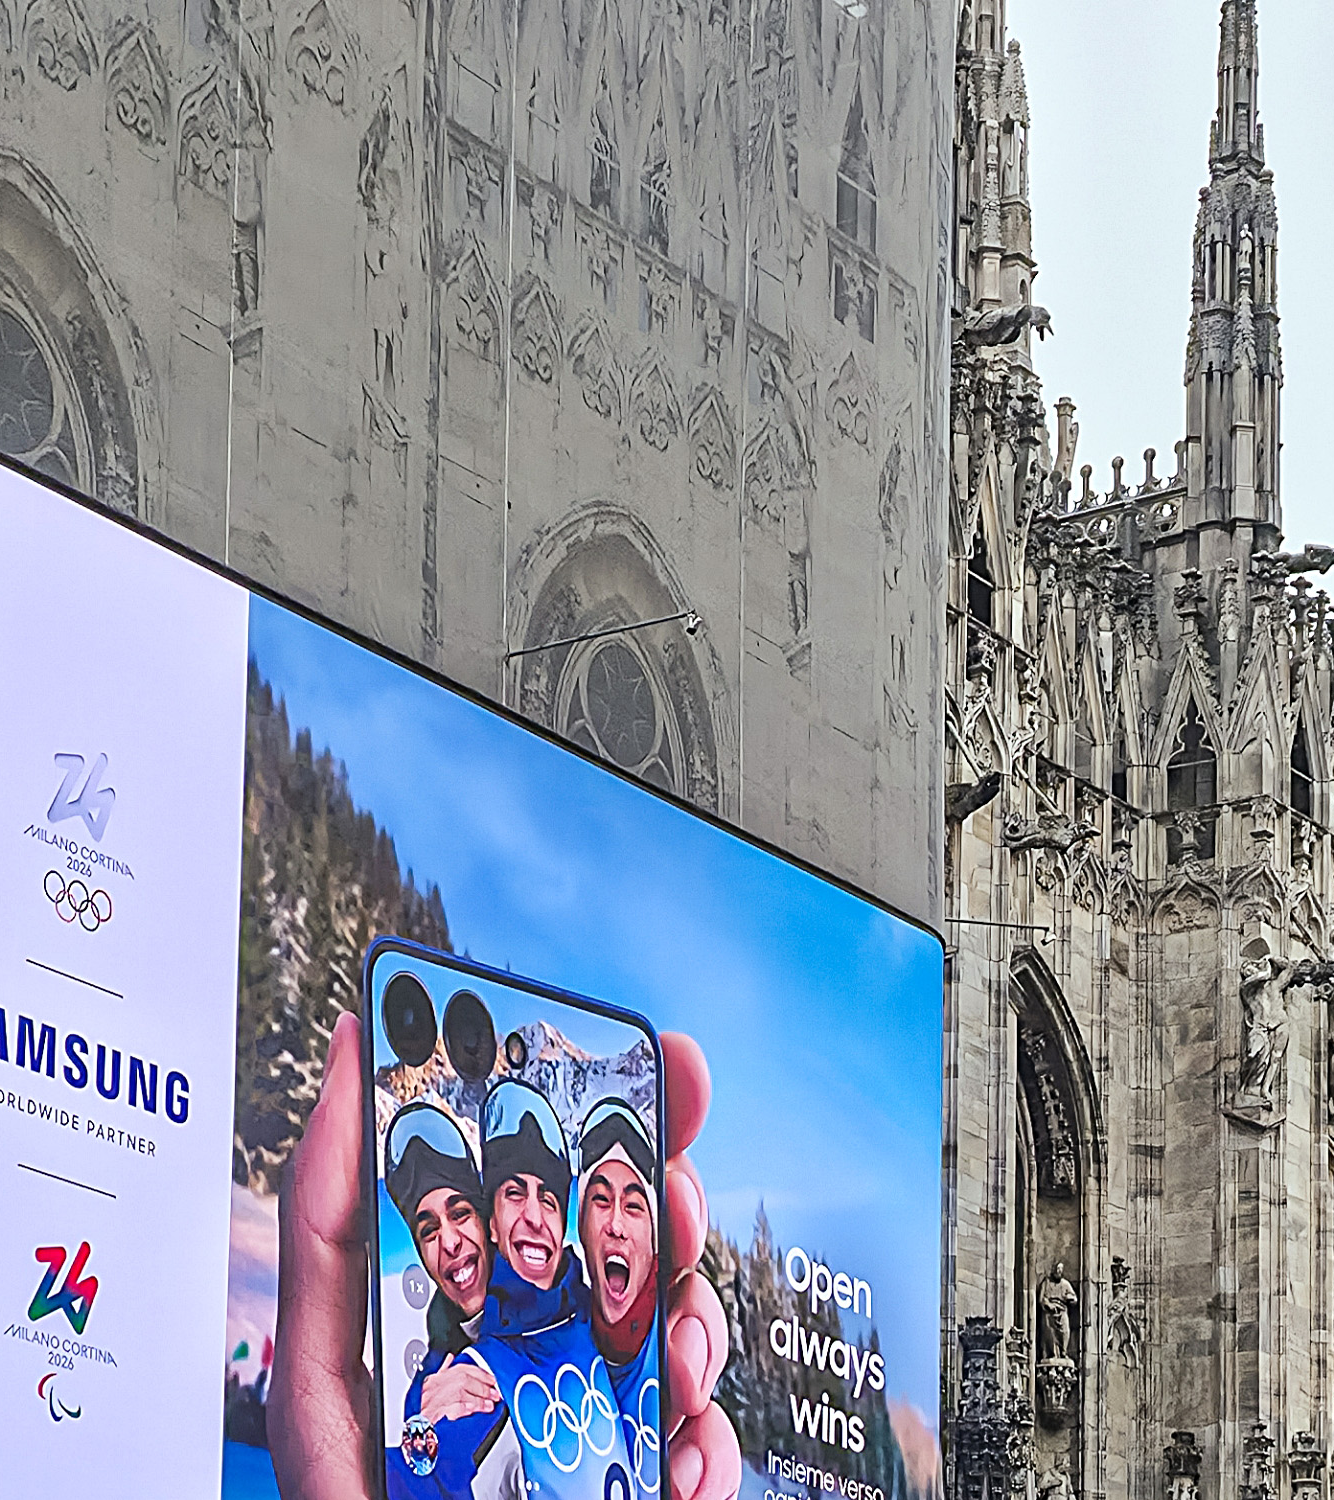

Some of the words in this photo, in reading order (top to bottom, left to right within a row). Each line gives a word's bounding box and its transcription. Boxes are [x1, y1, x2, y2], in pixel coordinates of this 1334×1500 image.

[23, 824, 79, 857] MILANO
[79, 845, 135, 881] CORTINA
[66, 856, 93, 878] 2026
[86, 1118, 157, 1158] PARTNER
[784, 1246, 873, 1319] Open
[3, 1323, 61, 1351] MILANO
[61, 1340, 118, 1369] CORTINA
[47, 1350, 75, 1372] 2026
[769, 1314, 886, 1399] always
[789, 1391, 866, 1453] wins
[767, 1449, 835, 1493] Insieme
